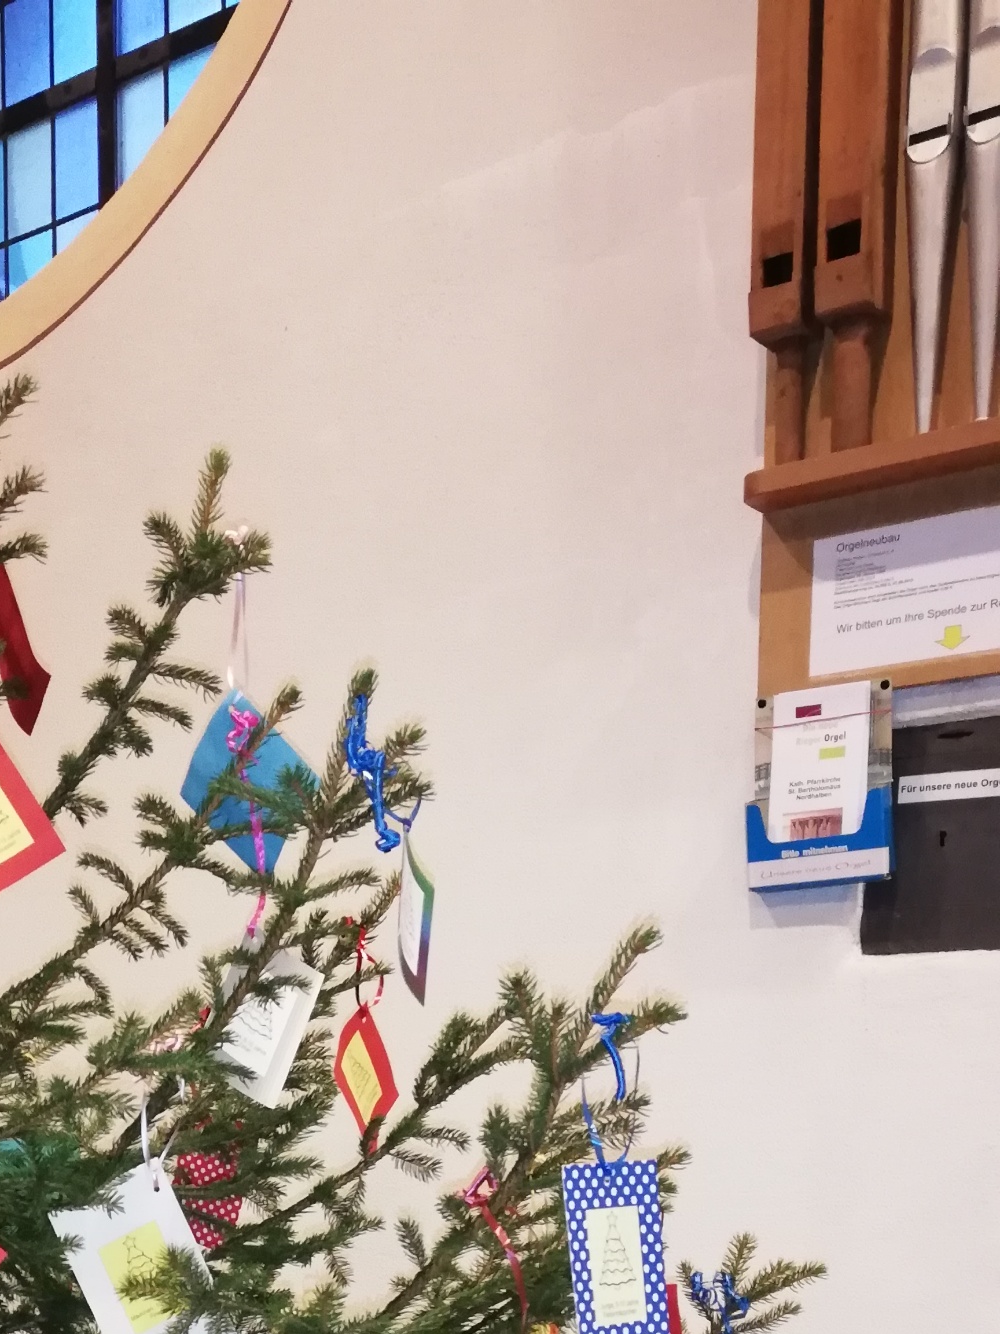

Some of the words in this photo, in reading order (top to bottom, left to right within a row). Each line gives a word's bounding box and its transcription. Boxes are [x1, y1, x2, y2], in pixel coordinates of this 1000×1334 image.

[836, 535, 901, 552] Orgelneubau
[836, 623, 853, 633] Wir
[856, 619, 883, 631] bitten
[886, 616, 901, 626] um
[904, 612, 924, 622] Ihre
[927, 604, 967, 619] Spende
[970, 601, 987, 611] zur
[824, 731, 846, 742] Orgel
[901, 784, 916, 794] Für
[920, 781, 951, 792] unsere
[954, 780, 978, 789] neue
[781, 850, 800, 859] Bitte
